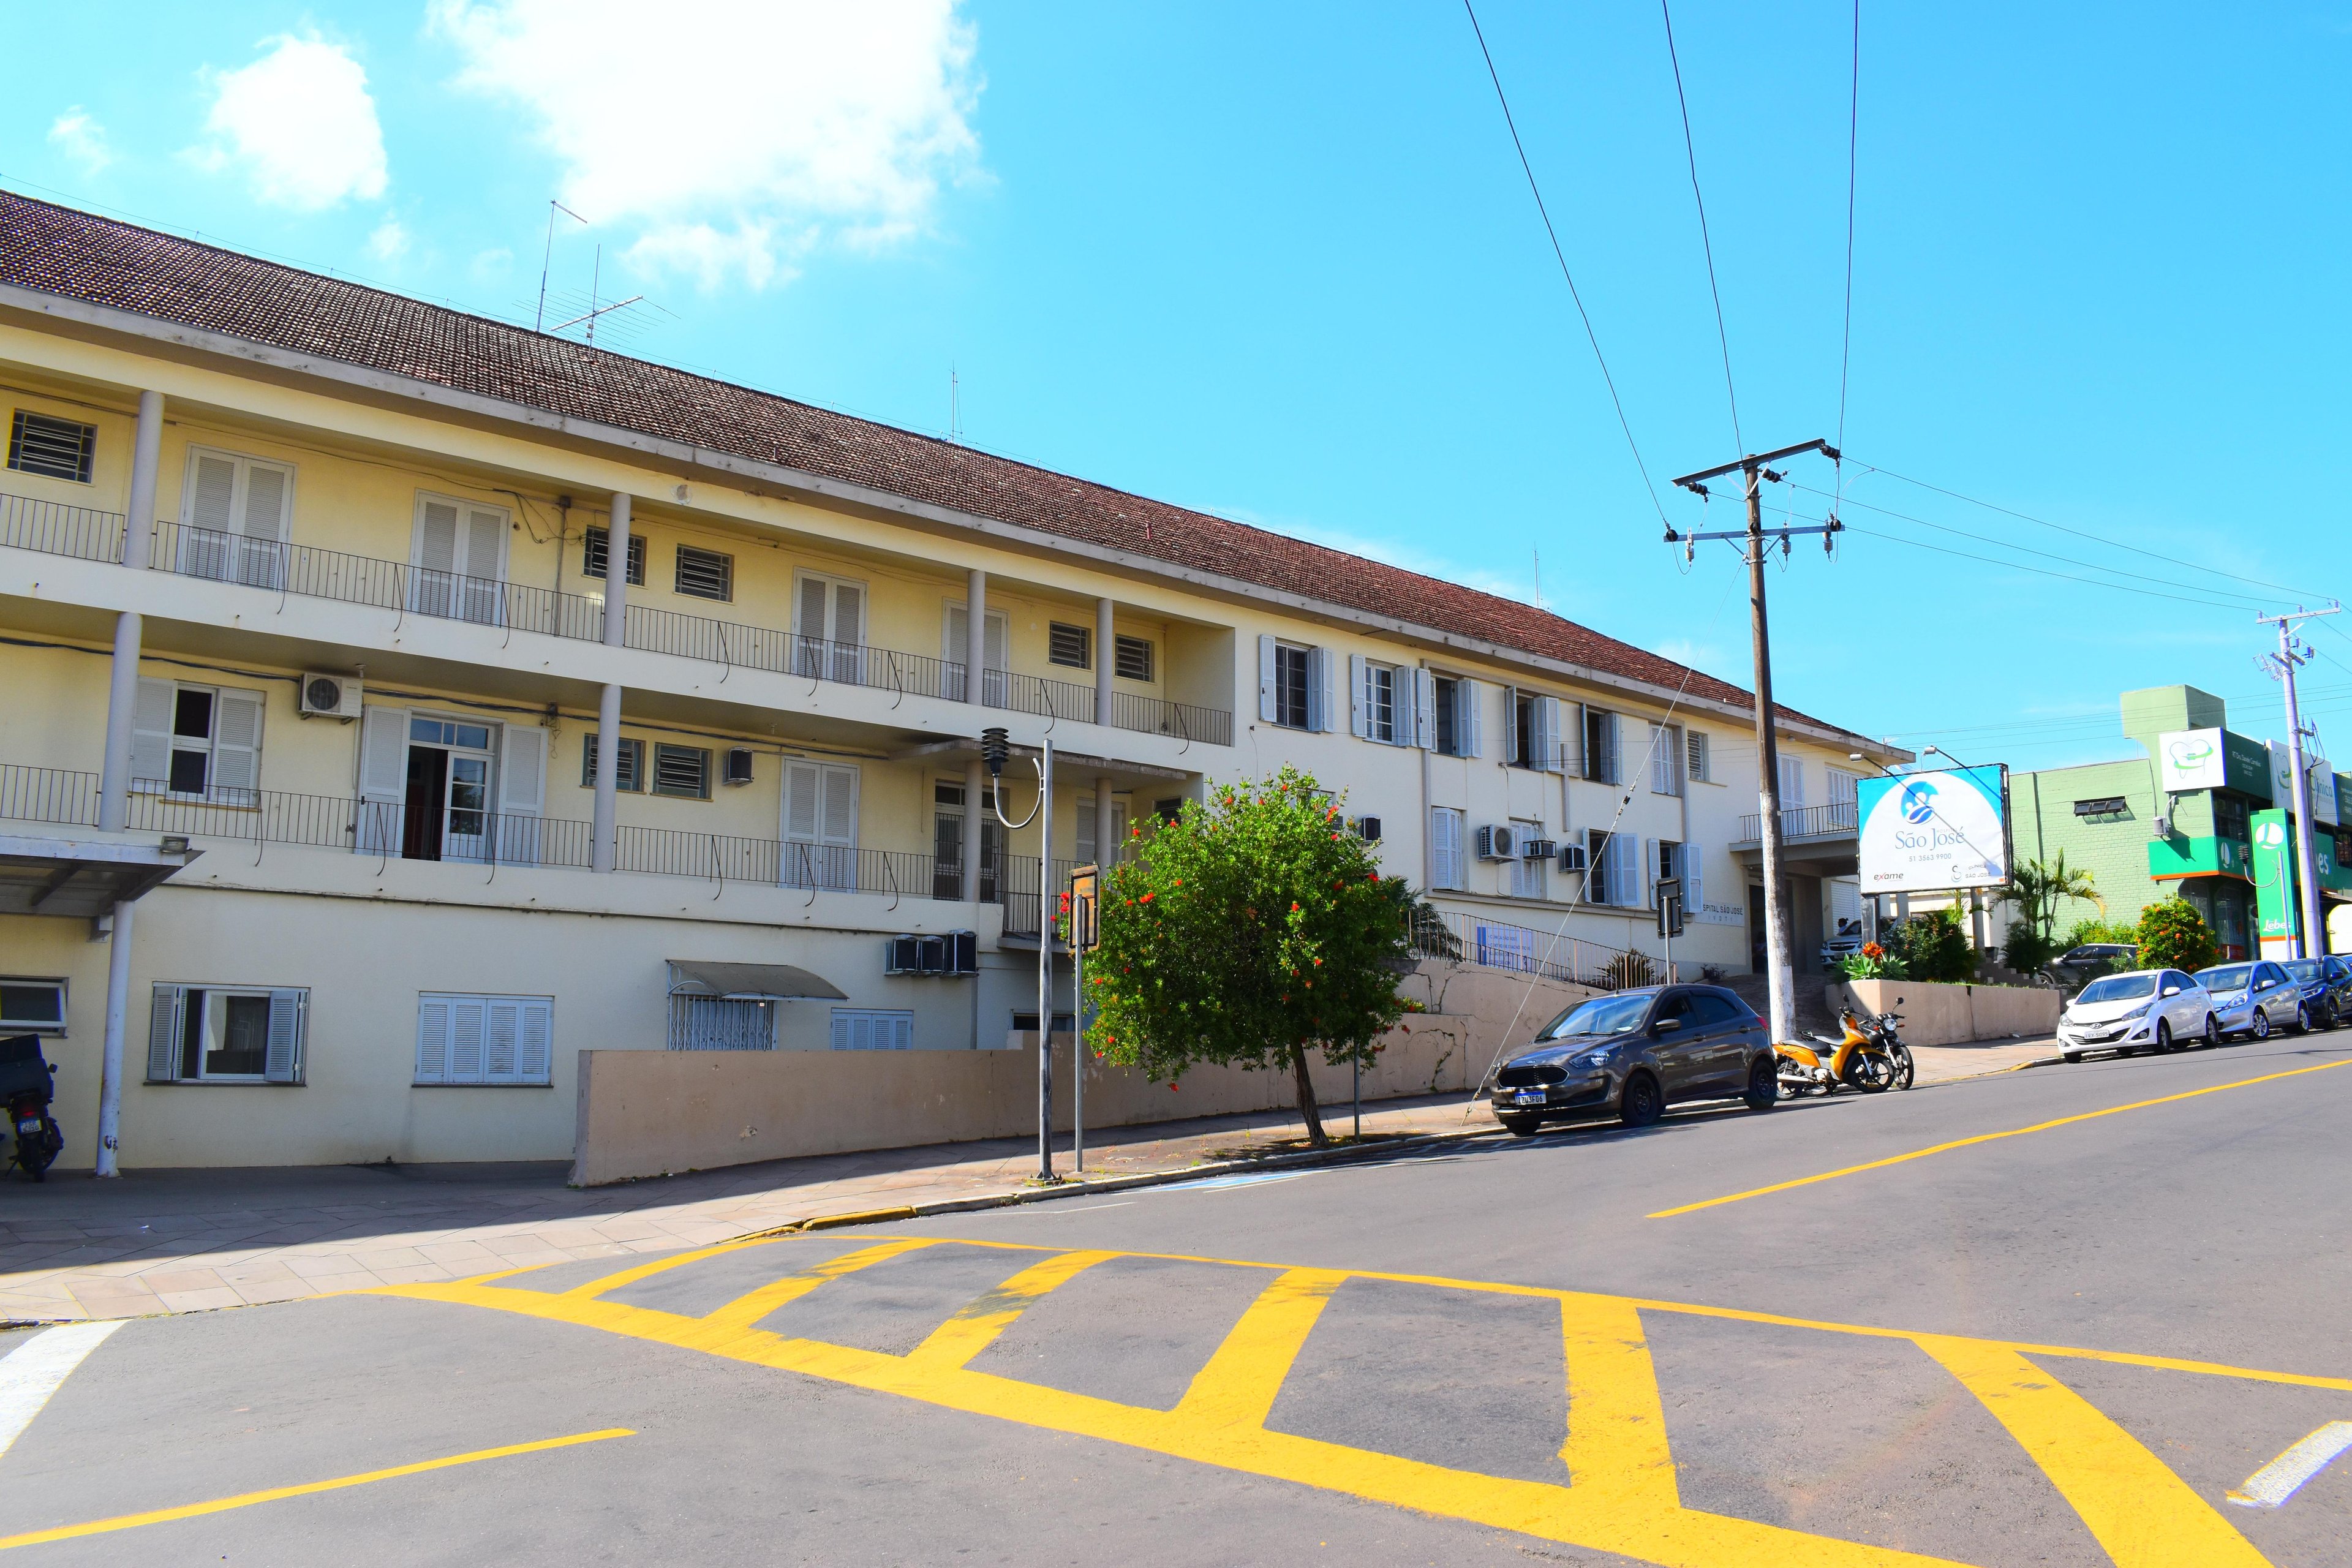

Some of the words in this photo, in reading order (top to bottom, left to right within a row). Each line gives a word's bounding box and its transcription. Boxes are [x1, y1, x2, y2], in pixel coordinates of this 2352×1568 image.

[1895, 831, 1927, 849] São
[1930, 826, 1964, 851] José
[1874, 872, 1904, 882] exame
[1703, 904, 1719, 913] SPITAL
